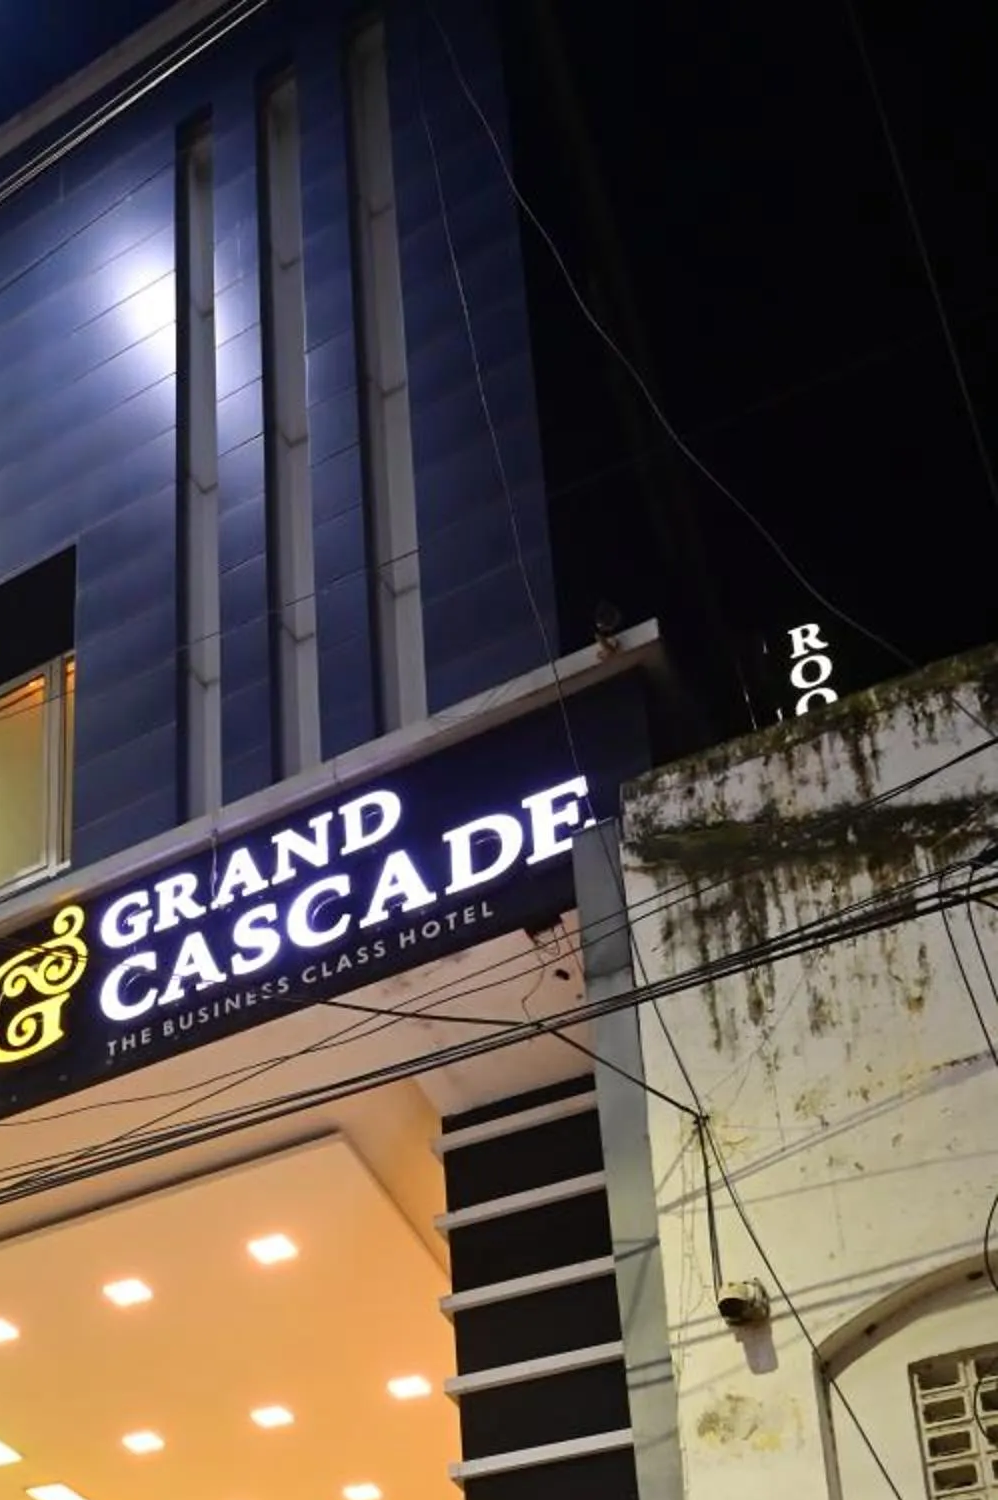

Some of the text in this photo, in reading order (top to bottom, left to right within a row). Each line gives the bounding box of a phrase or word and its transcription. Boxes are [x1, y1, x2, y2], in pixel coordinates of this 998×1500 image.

[99, 774, 597, 1022] CASCADE
[101, 788, 401, 949] GRAND
[107, 902, 495, 1056] THE BUSINESS CLASS HOTEL
